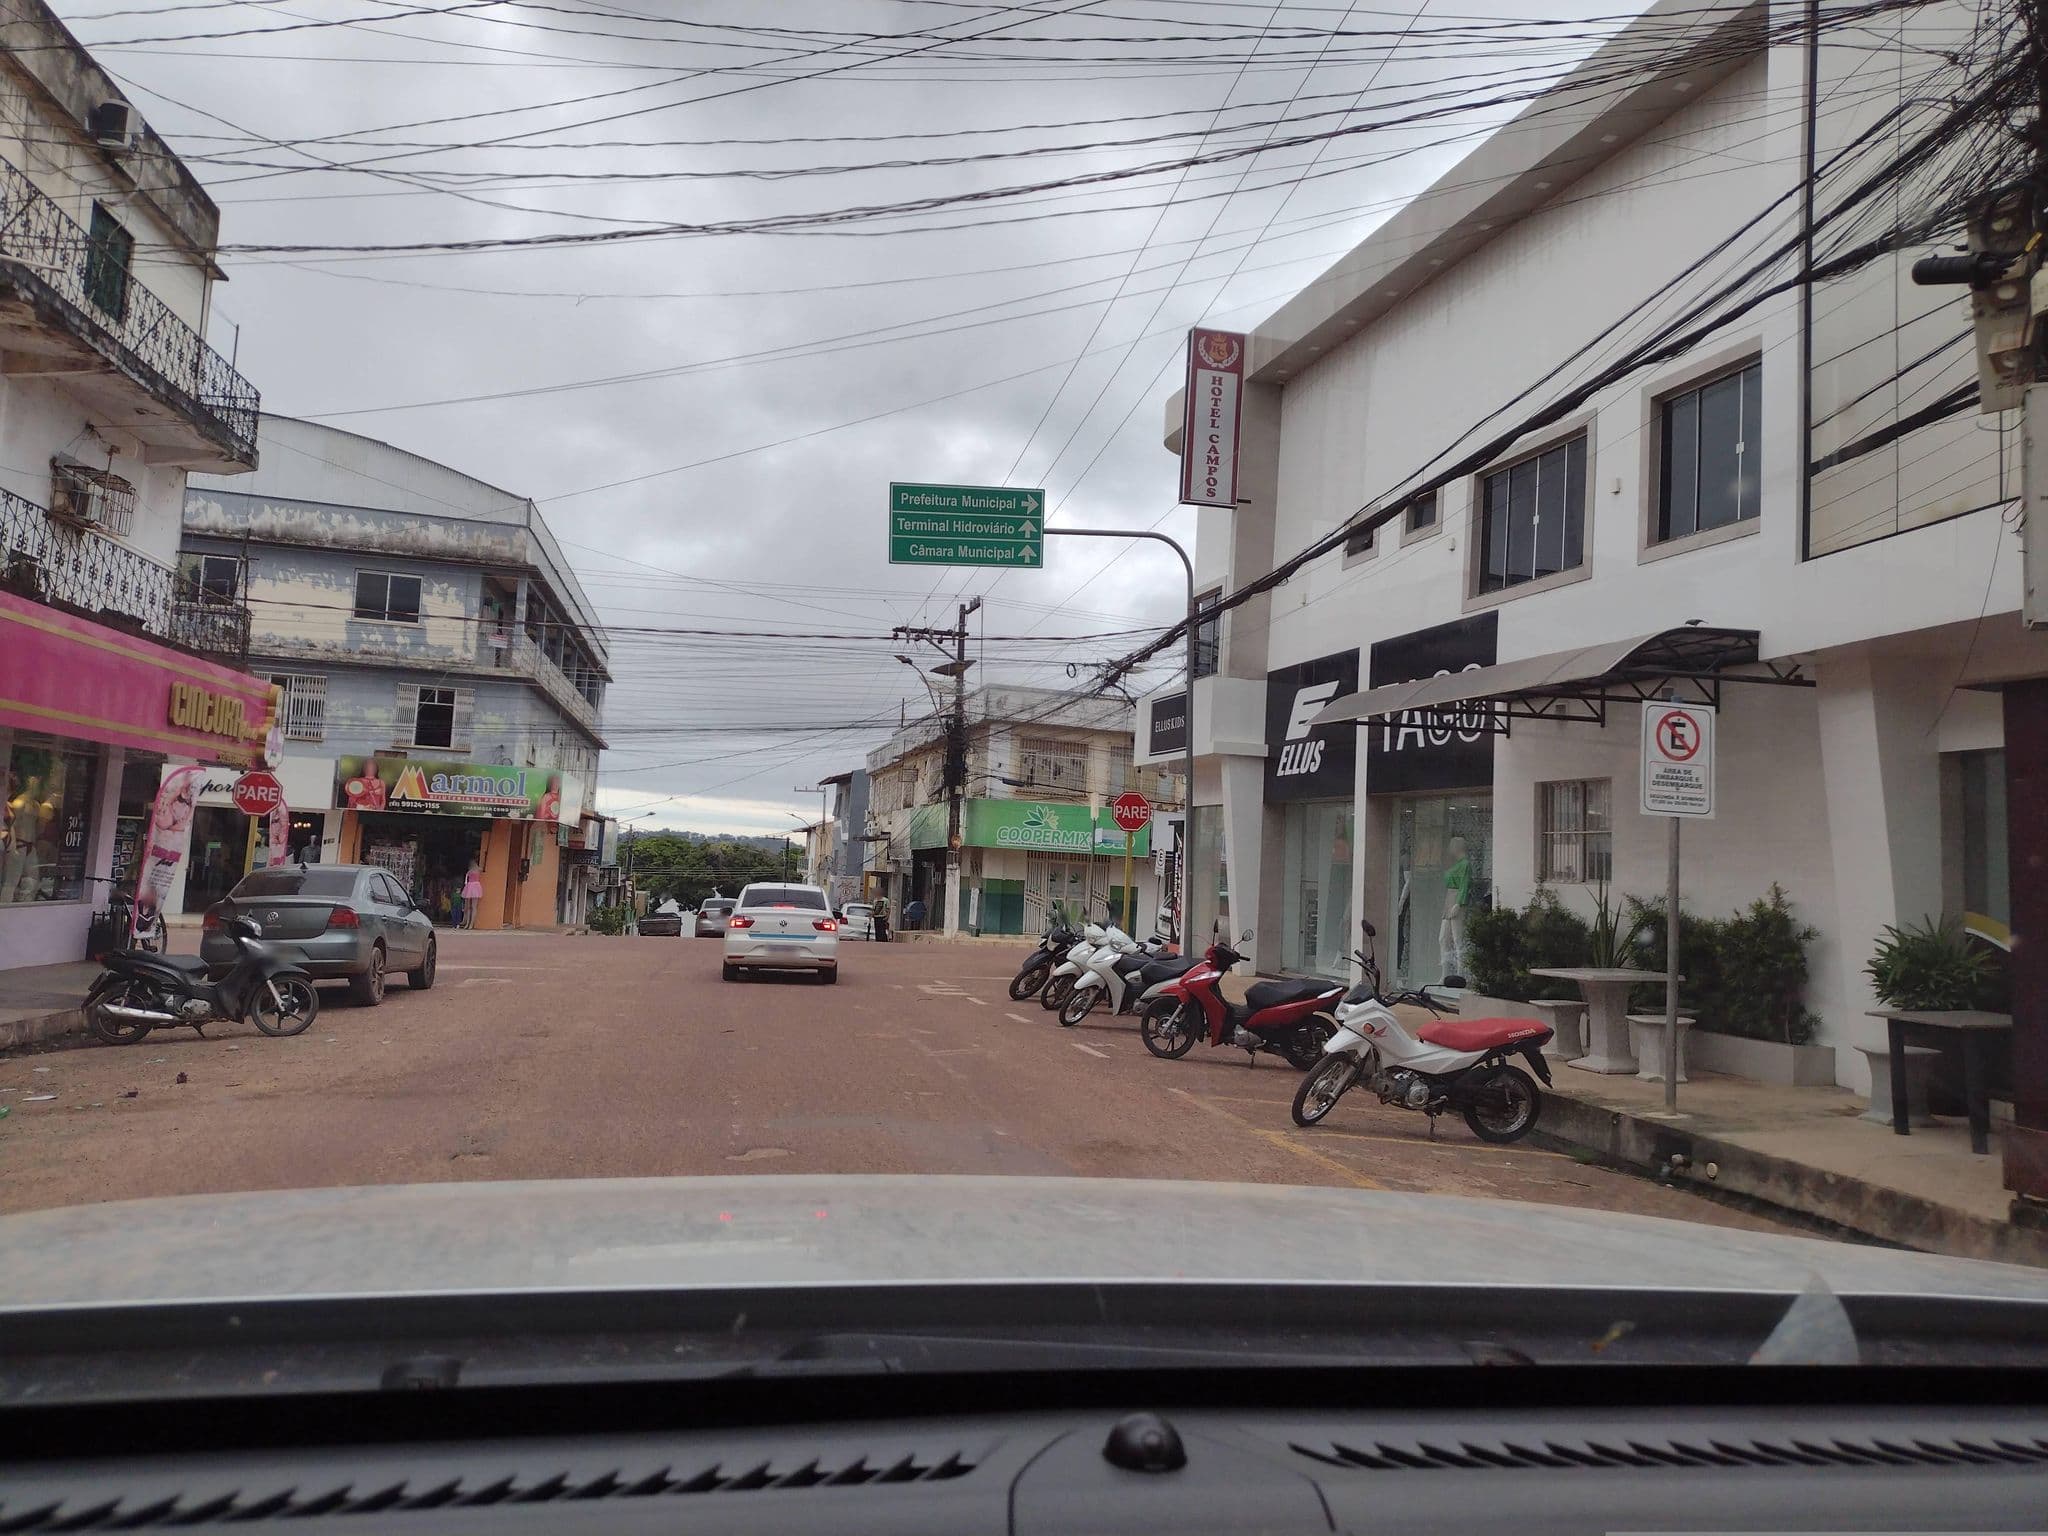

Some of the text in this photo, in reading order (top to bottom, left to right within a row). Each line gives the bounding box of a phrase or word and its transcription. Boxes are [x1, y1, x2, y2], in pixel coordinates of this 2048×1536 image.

[1205, 375, 1223, 498] HOTEL CAMPOS
[901, 492, 1016, 511] Prefeitura Municipal
[897, 518, 1015, 535] Terminal Hidroviário
[910, 543, 1015, 561] Câmara Municipal
[1155, 719, 1170, 733] ELLUS
[1276, 739, 1325, 777] ELLUS
[390, 765, 528, 799] Marmol
[236, 784, 279, 802] PARE
[1115, 804, 1148, 819] PARE
[65, 831, 83, 847] OFF
[996, 826, 1092, 847] COOPERMIX
[1507, 1028, 1537, 1039] HONDA
